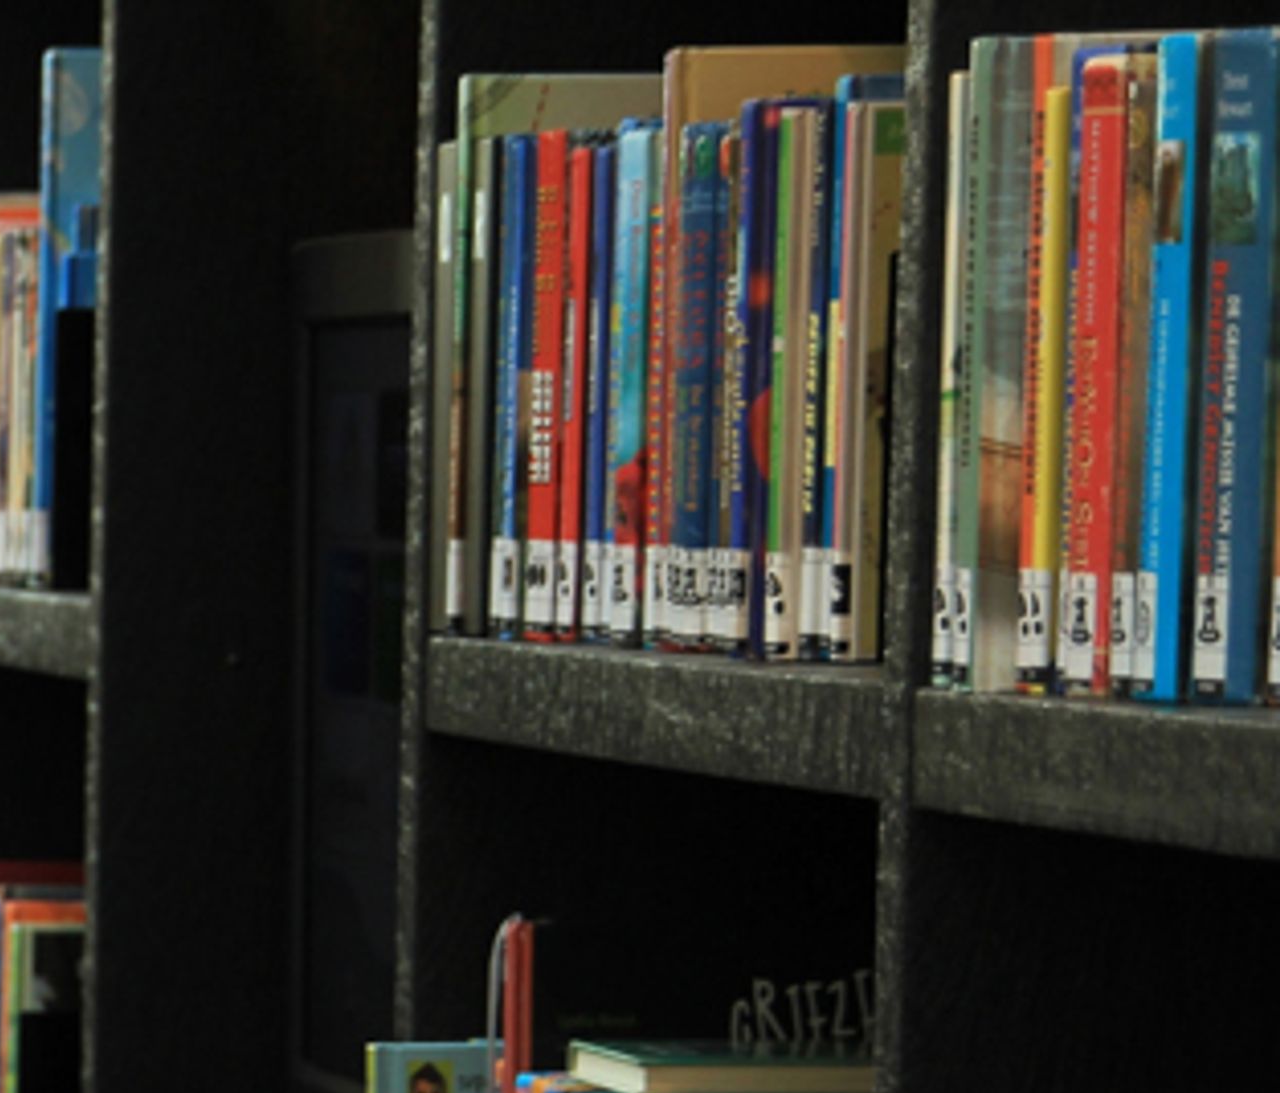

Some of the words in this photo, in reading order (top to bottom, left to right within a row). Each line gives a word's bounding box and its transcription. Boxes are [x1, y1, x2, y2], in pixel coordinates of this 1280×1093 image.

[1087, 119, 1101, 223] MATTHEW
[1225, 293, 1242, 319] DE
[1221, 323, 1240, 414] GEHEIME
[1219, 418, 1237, 487] MISSIE
[1217, 492, 1233, 535] VAN
[1216, 539, 1232, 575] HET
